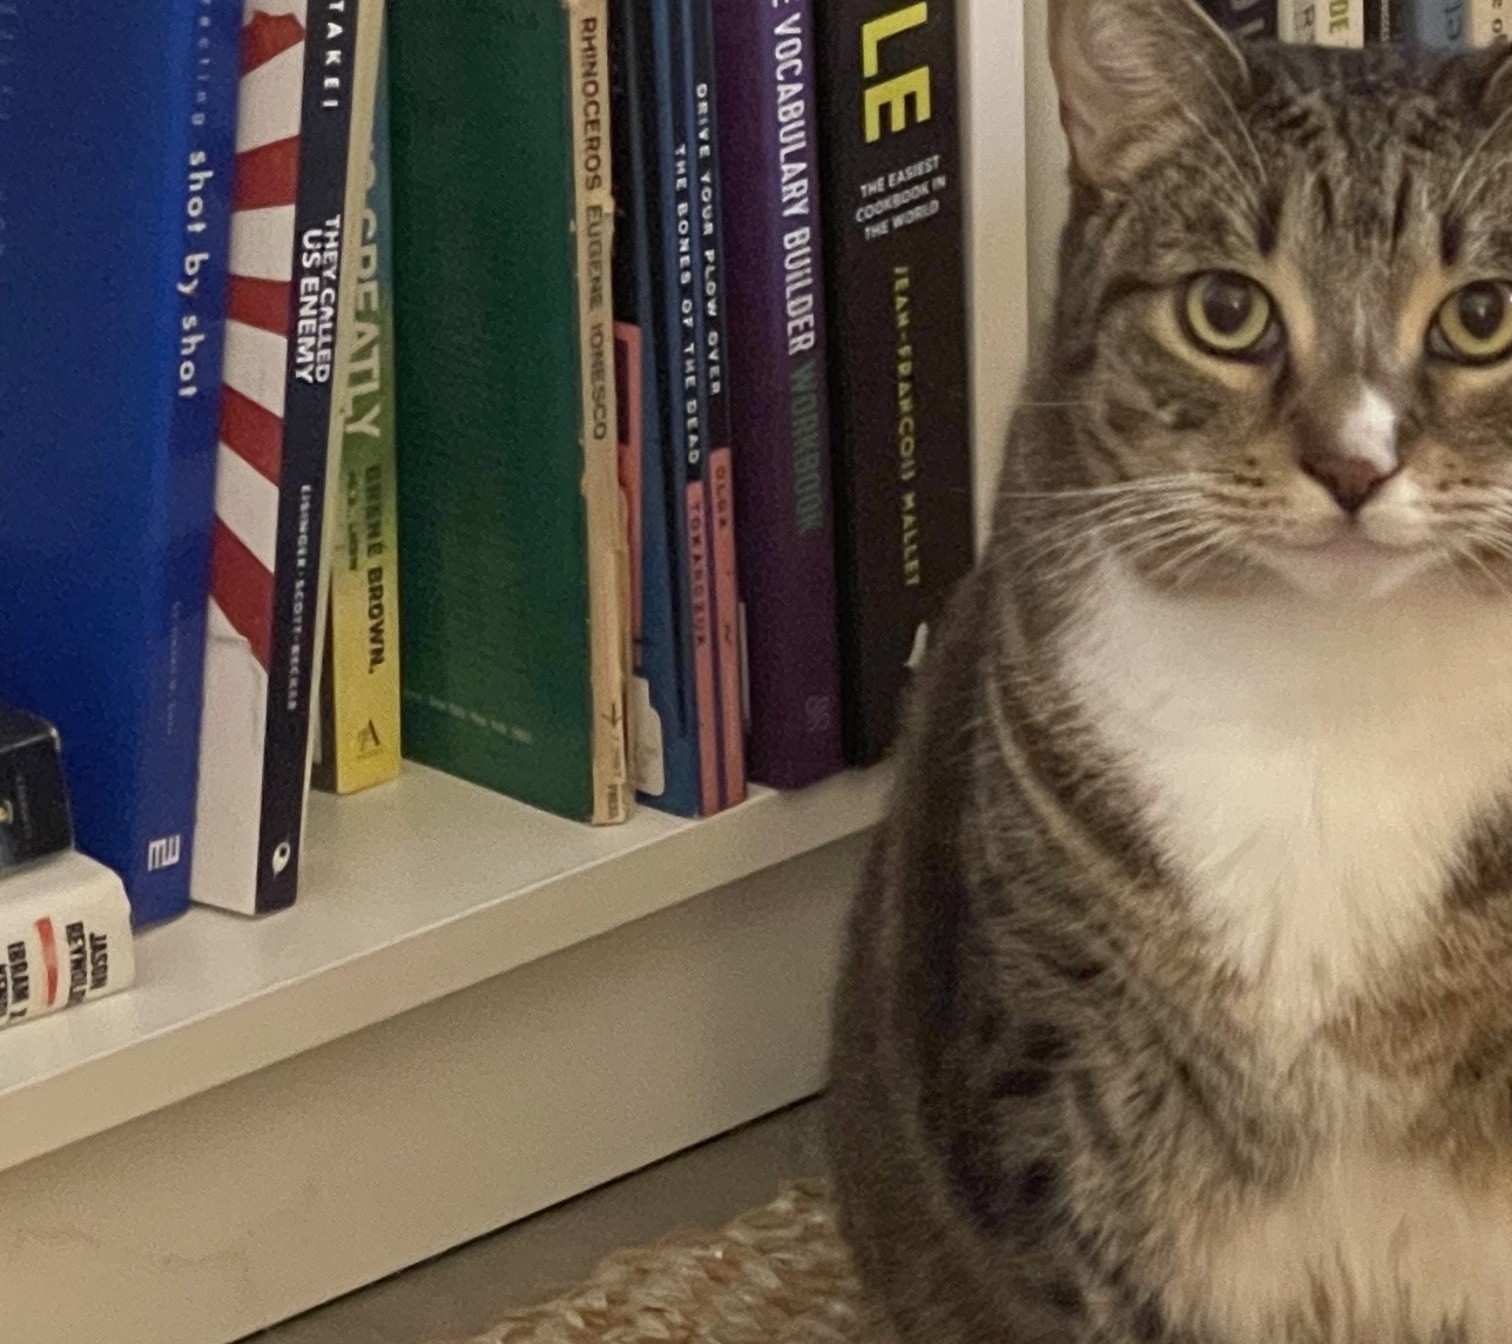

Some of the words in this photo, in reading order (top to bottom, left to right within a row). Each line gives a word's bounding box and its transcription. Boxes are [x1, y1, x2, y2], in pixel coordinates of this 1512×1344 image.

[319, 0, 347, 109] TAKEI
[579, 16, 603, 192] RHINOCEROS
[694, 83, 709, 159] DRIVE
[773, 12, 809, 218] VOCABULARY
[187, 150, 213, 237] shot
[674, 142, 688, 191] THE
[855, 182, 931, 223] COOKBOOK
[931, 174, 947, 196] IN
[860, 176, 888, 199] THE
[888, 155, 940, 192] EASIEST
[699, 170, 715, 236] YOUR
[864, 218, 890, 241] THE
[891, 199, 940, 232] WORLD
[177, 252, 209, 298] by
[299, 227, 325, 269] US
[319, 214, 342, 282] THEY
[584, 205, 606, 309] EUGENE
[675, 209, 693, 286] BONES
[679, 298, 696, 331] OF
[703, 249, 719, 319] PLOW
[782, 225, 815, 355] BUILDER
[177, 313, 204, 399] shot
[292, 275, 322, 382] ENEMY
[312, 285, 336, 381] CALLED
[588, 322, 609, 440] IONESCO
[681, 342, 698, 390] THE
[706, 331, 722, 397] OVER
[684, 400, 702, 466] DEAD
[788, 360, 823, 535] WORKBOOK
[899, 493, 922, 586] MALLET
[7, 940, 31, 1002] IBRAM
[88, 929, 109, 992] JASON
